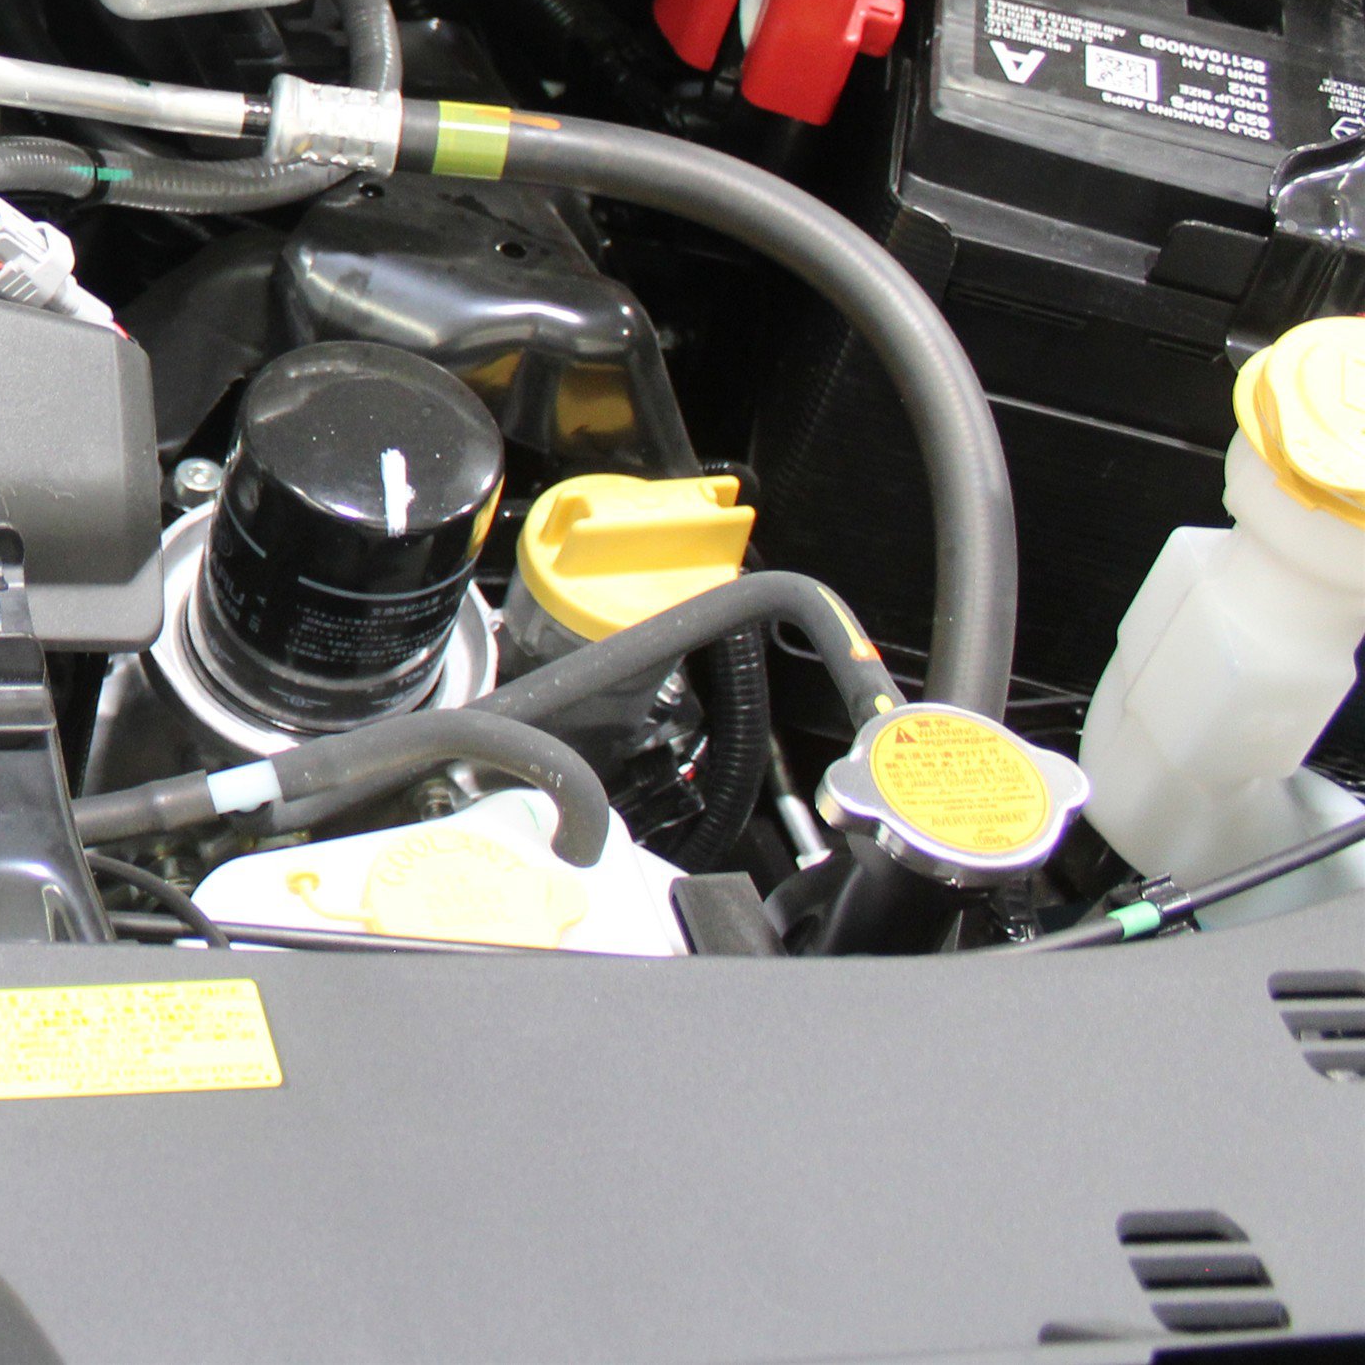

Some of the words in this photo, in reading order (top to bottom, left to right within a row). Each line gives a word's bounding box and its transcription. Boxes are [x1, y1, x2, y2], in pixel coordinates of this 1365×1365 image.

[1001, 29, 1071, 53] DISTRIBUTED
[1139, 33, 1269, 73] 82110AN00B
[1180, 56, 1205, 71] AH
[1206, 62, 1225, 76] 62
[1225, 67, 1267, 86] 20HR
[1101, 90, 1144, 110] AMPS
[1178, 83, 1213, 101] SIZE
[1226, 80, 1268, 102] LN2
[1169, 93, 1230, 120] AMPS
[1213, 91, 1269, 114] GROUP
[1146, 101, 1225, 129] CRANKING
[1232, 108, 1271, 130] 620
[1227, 121, 1271, 140] COLD
[930, 811, 1028, 828] AVERTISSEMENT
